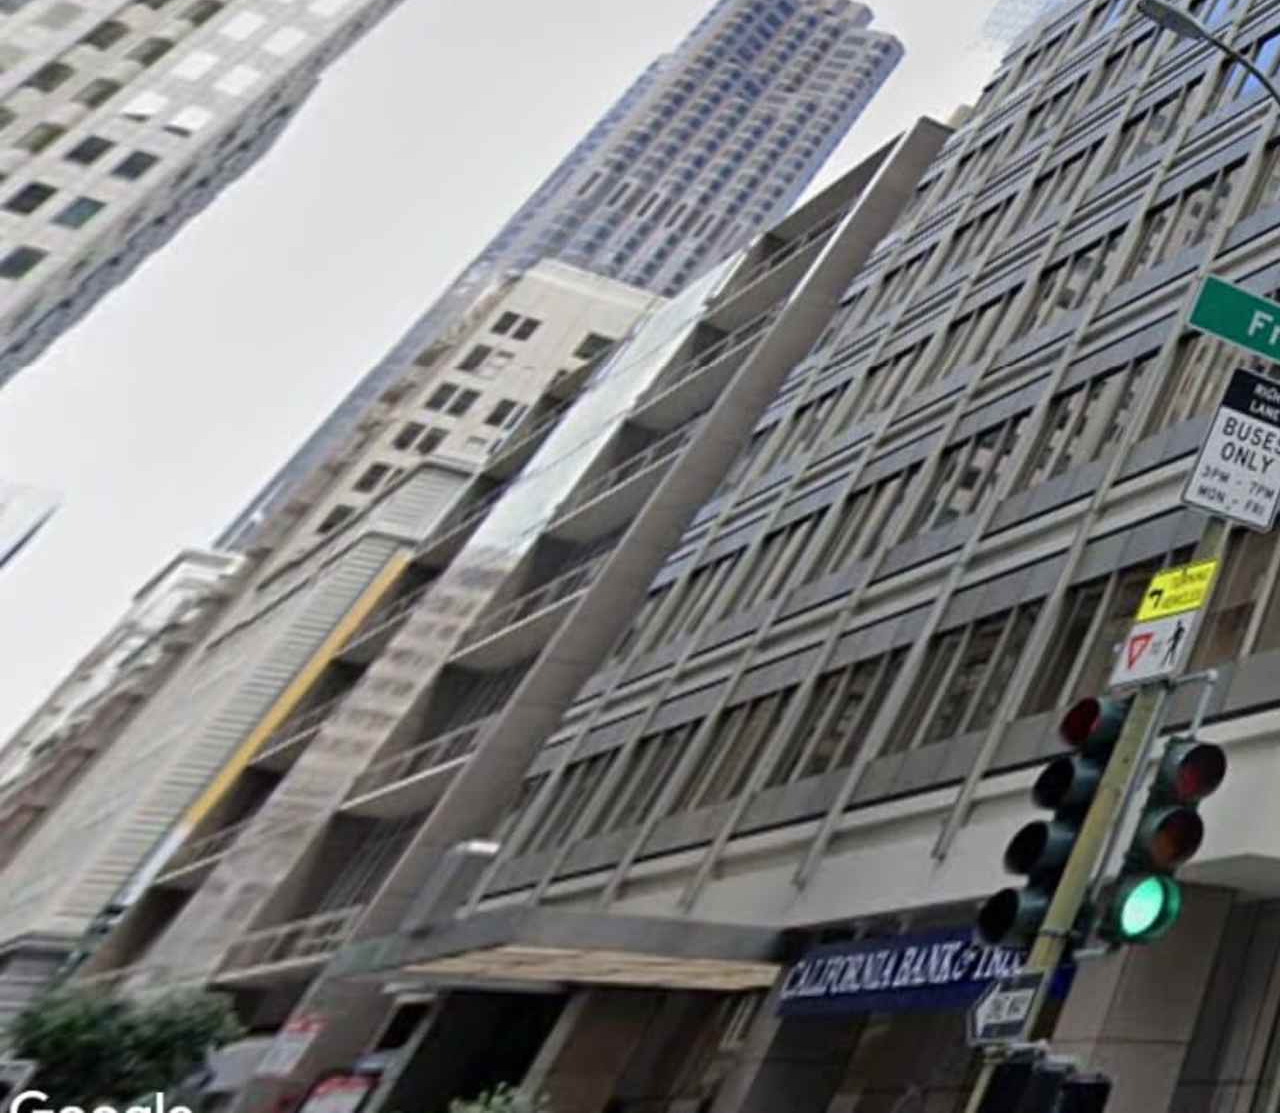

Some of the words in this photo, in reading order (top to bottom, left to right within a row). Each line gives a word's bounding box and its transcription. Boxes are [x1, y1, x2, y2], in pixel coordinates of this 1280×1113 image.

[1220, 441, 1275, 475] ONLY
[1198, 485, 1226, 503] MON
[1249, 480, 1275, 499] 7PM
